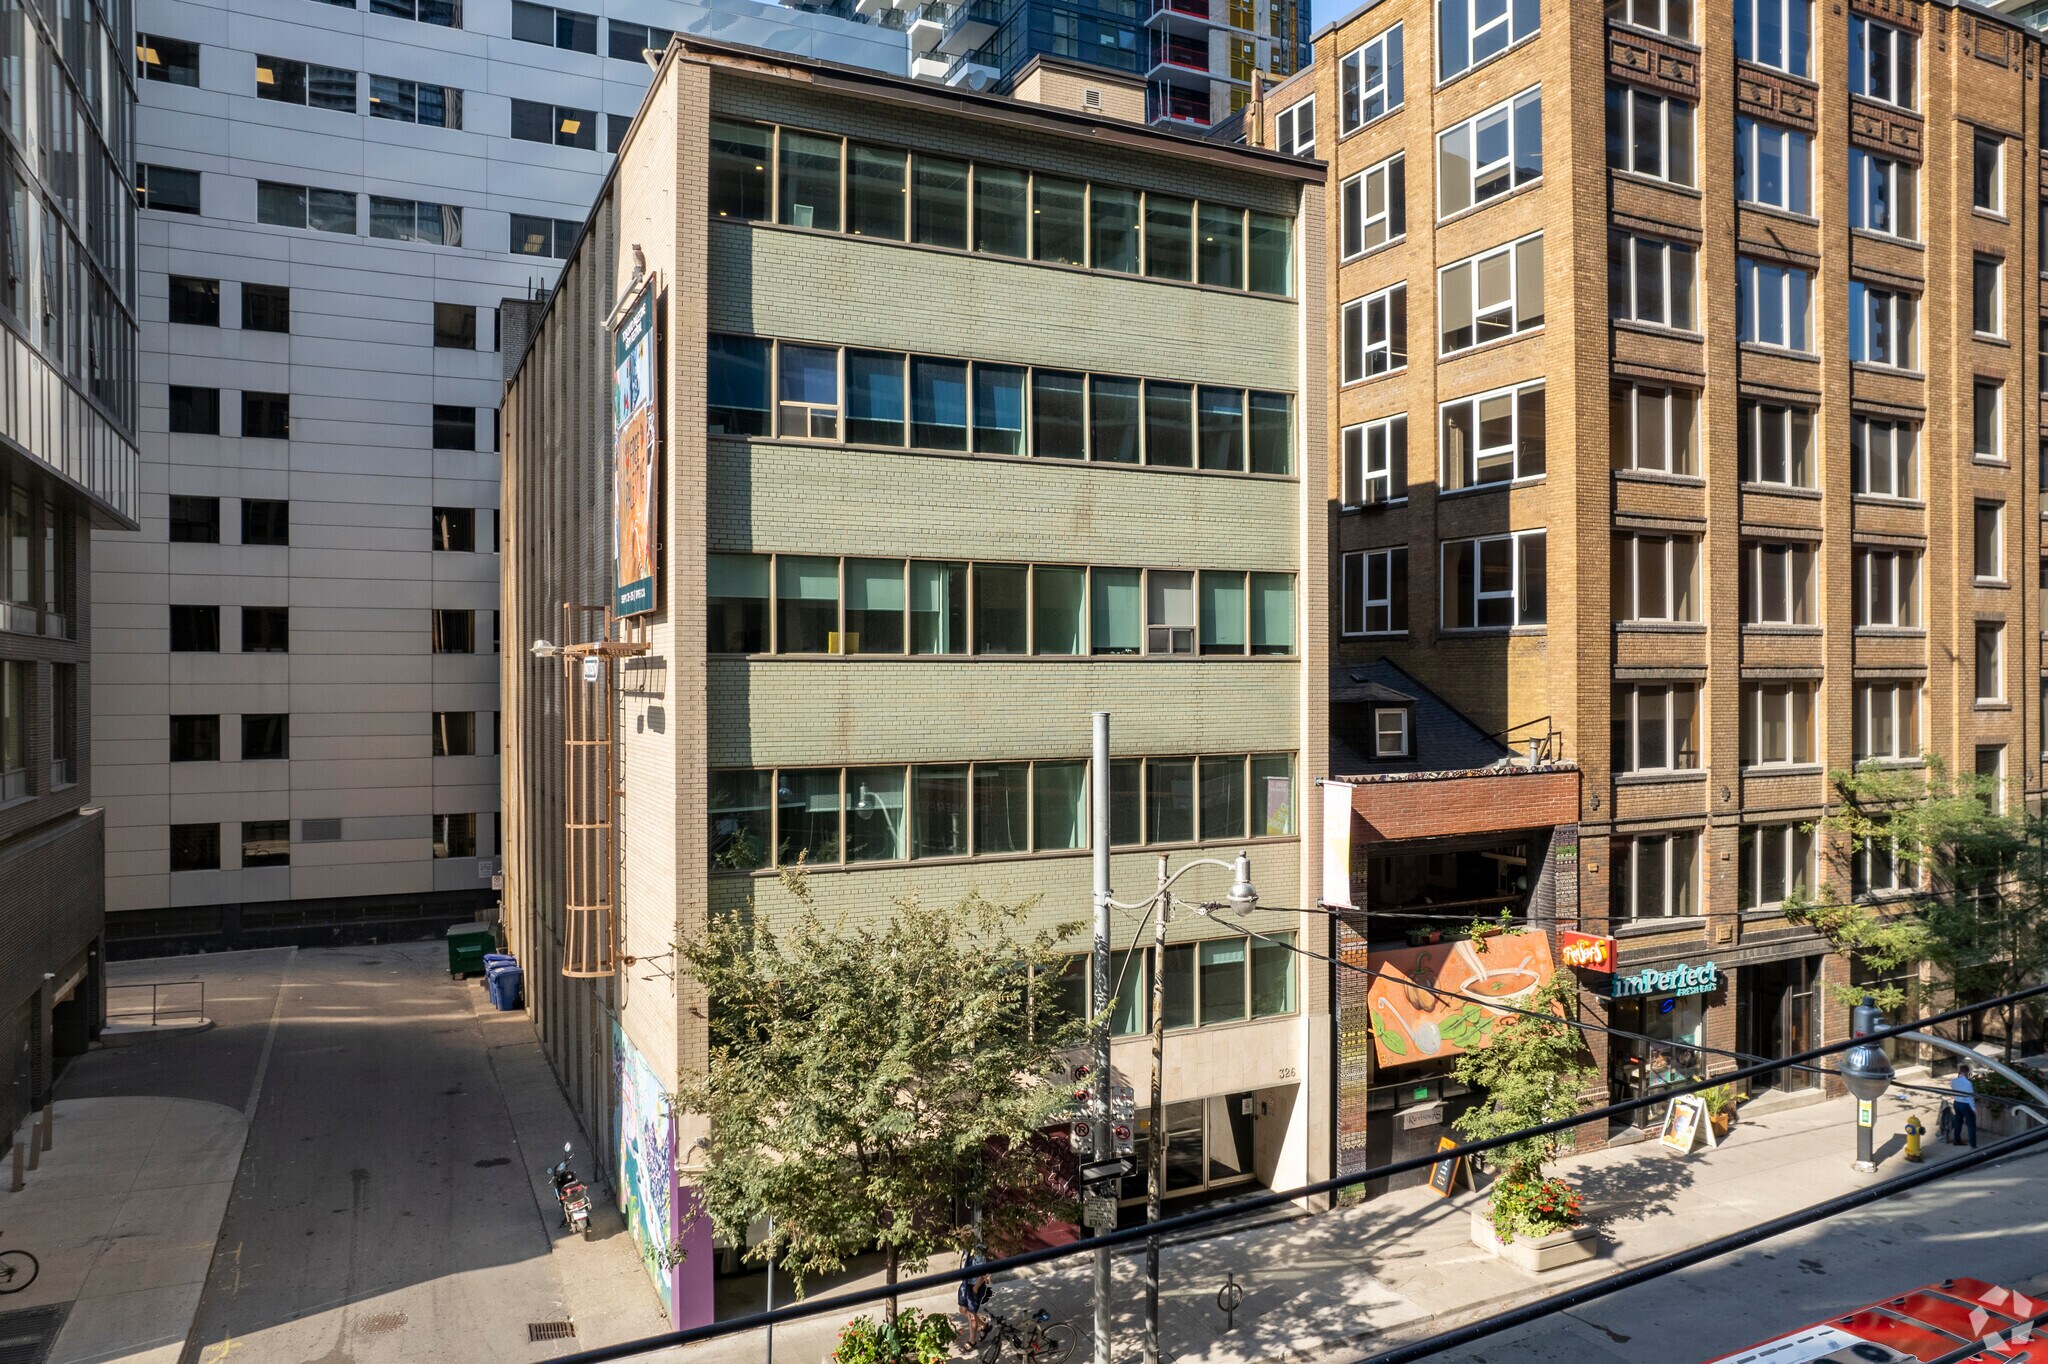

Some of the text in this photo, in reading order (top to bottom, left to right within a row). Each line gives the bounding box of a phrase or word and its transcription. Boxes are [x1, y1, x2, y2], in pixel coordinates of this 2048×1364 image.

[1612, 961, 1718, 998] imPerfect
[1676, 982, 1717, 997] FRESH EATS
[1279, 1067, 1296, 1079] 326
